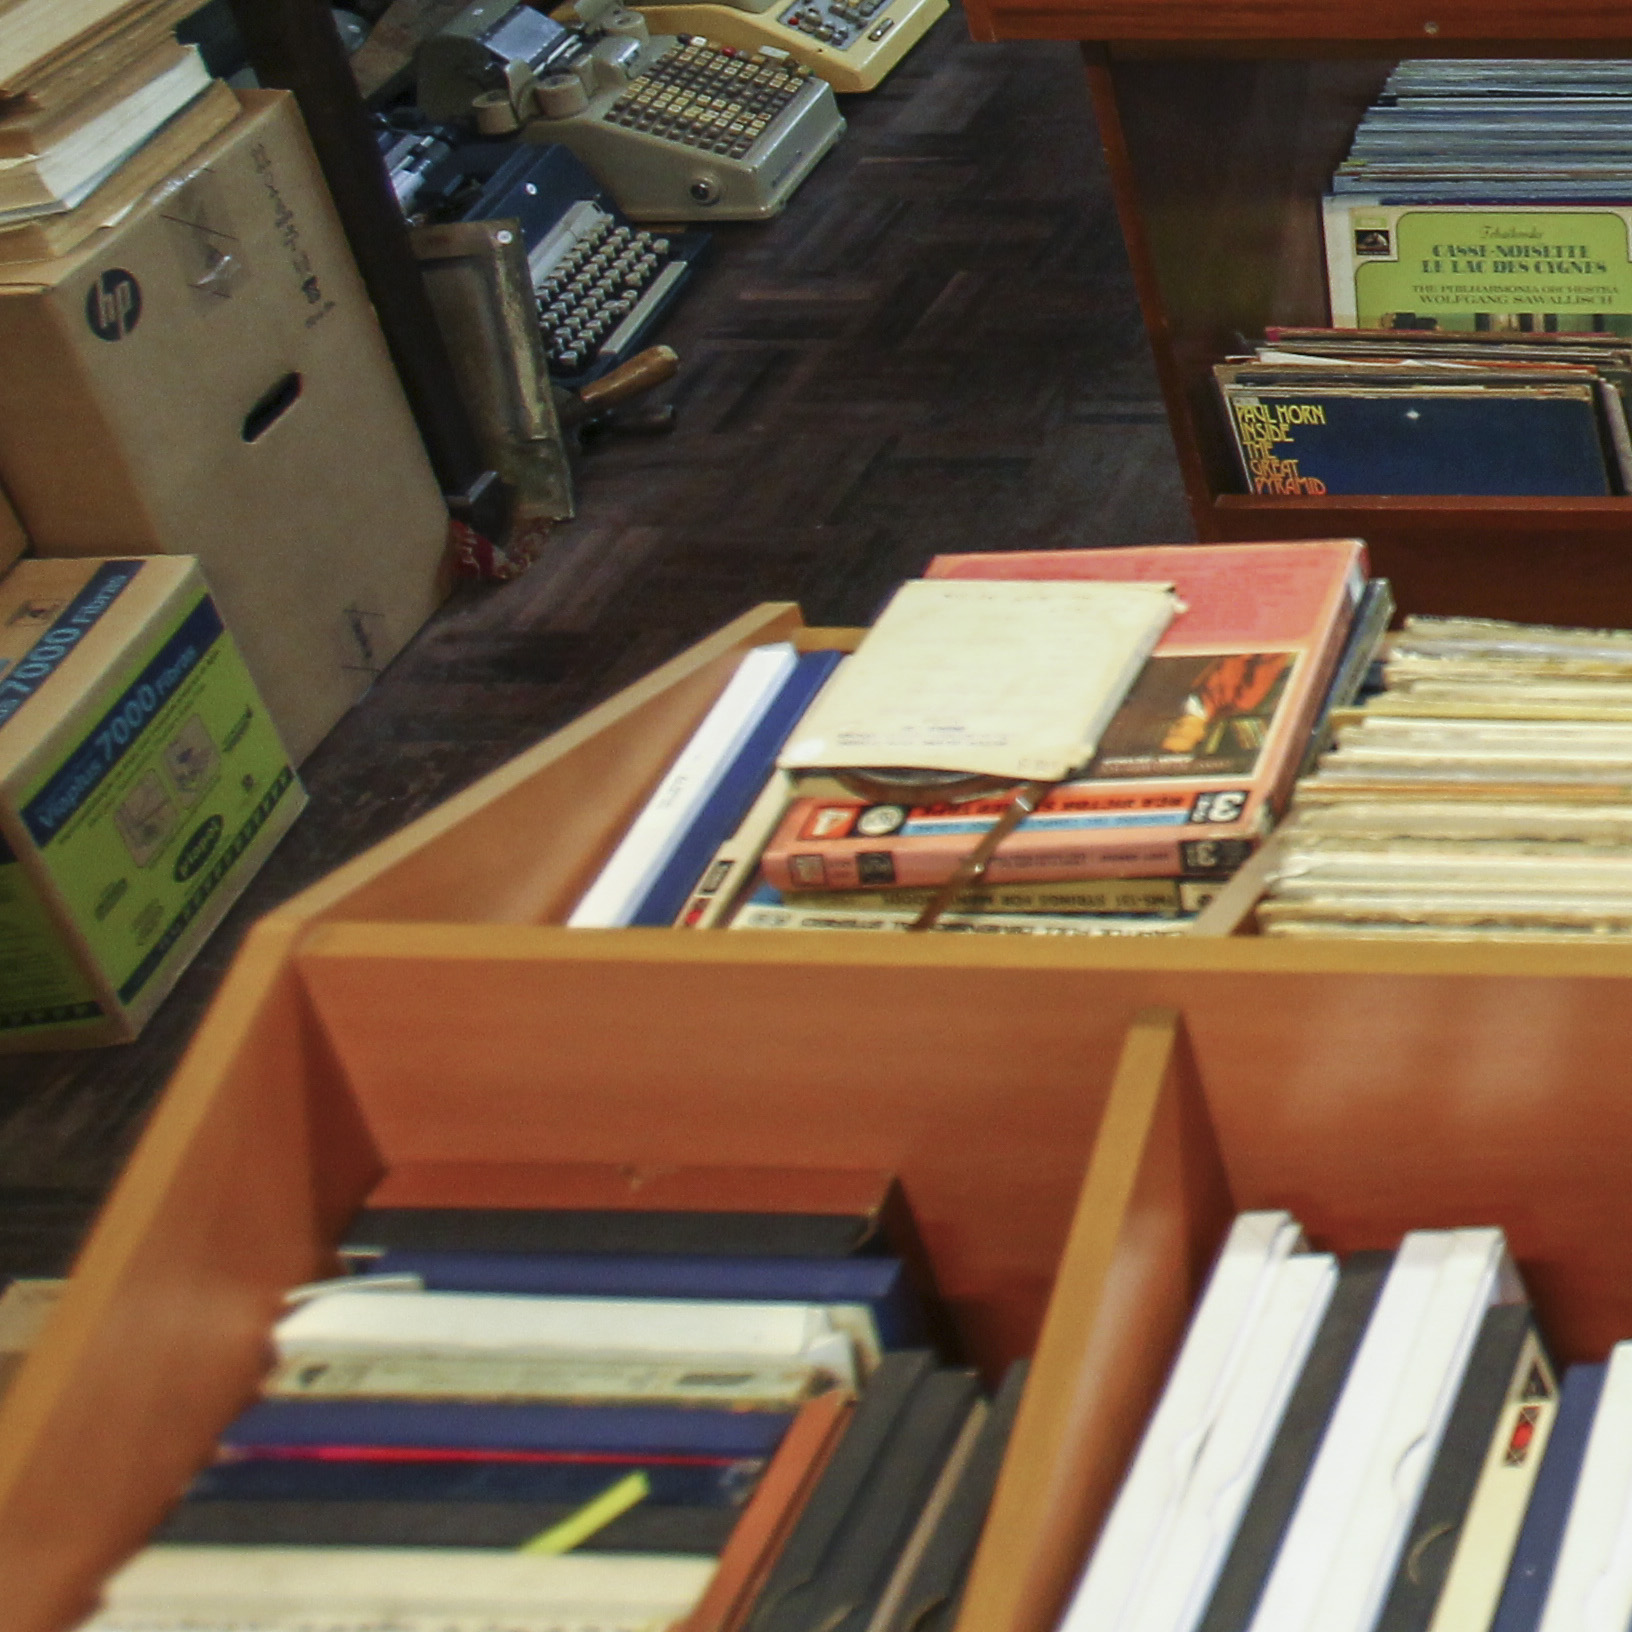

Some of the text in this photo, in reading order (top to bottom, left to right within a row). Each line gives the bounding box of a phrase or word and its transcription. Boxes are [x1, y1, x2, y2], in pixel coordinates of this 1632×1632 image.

[1432, 245, 1589, 259] CASSE-NOISETTE
[1422, 260, 1607, 274] LE LAC DES CYGNES
[93, 270, 134, 339] hp
[1420, 295, 1614, 305] WOLFGANG SAWALLISCH
[1235, 405, 1326, 425] PAUL HORN
[1240, 424, 1295, 442] INSIDE
[1242, 442, 1277, 459] THE
[1251, 459, 1299, 476] GREAT
[1254, 477, 1327, 495] PYRAMID
[95, 683, 158, 761] 7000
